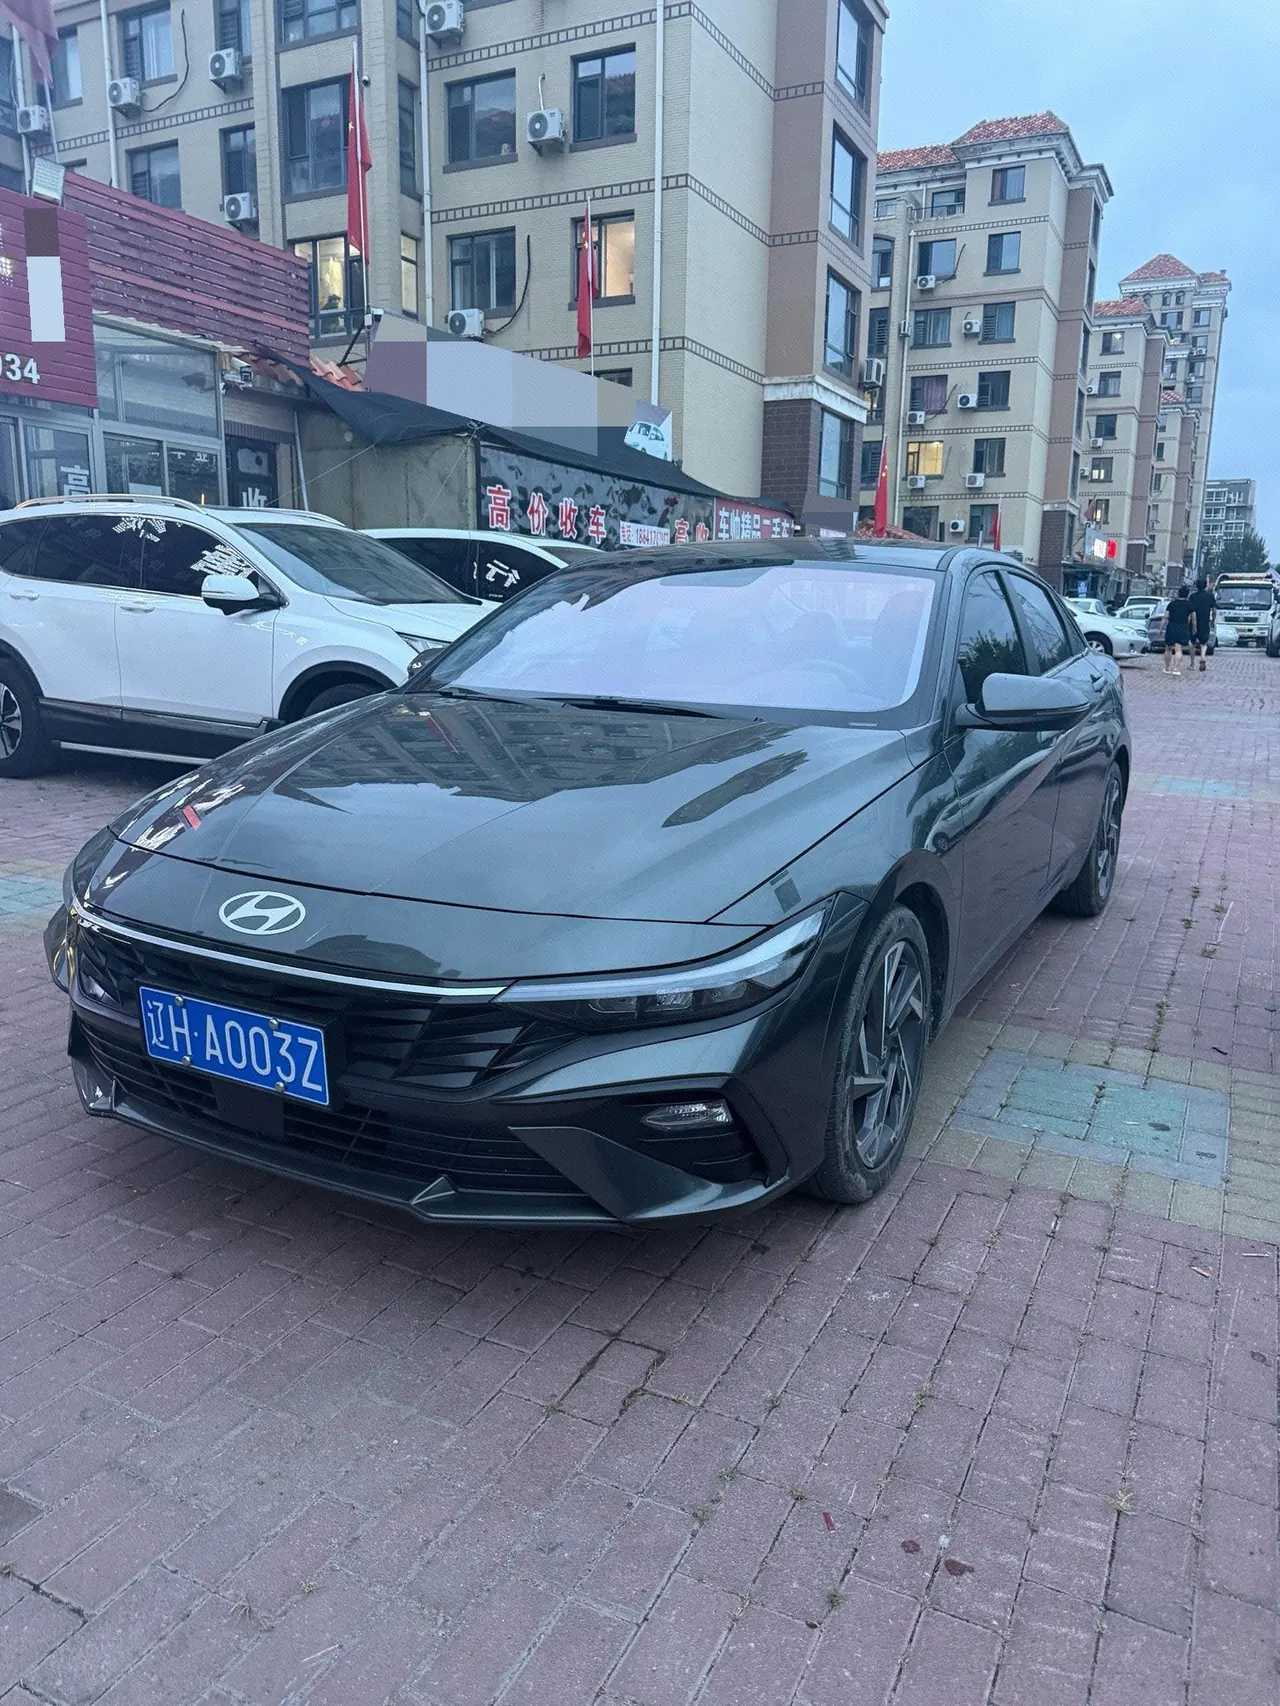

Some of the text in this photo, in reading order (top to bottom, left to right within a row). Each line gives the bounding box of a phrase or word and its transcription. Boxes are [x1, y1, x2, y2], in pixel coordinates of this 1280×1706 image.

[0, 353, 41, 384] 34
[486, 484, 607, 544] 高价收车
[146, 999, 323, 1093] 辽H·A003Z
